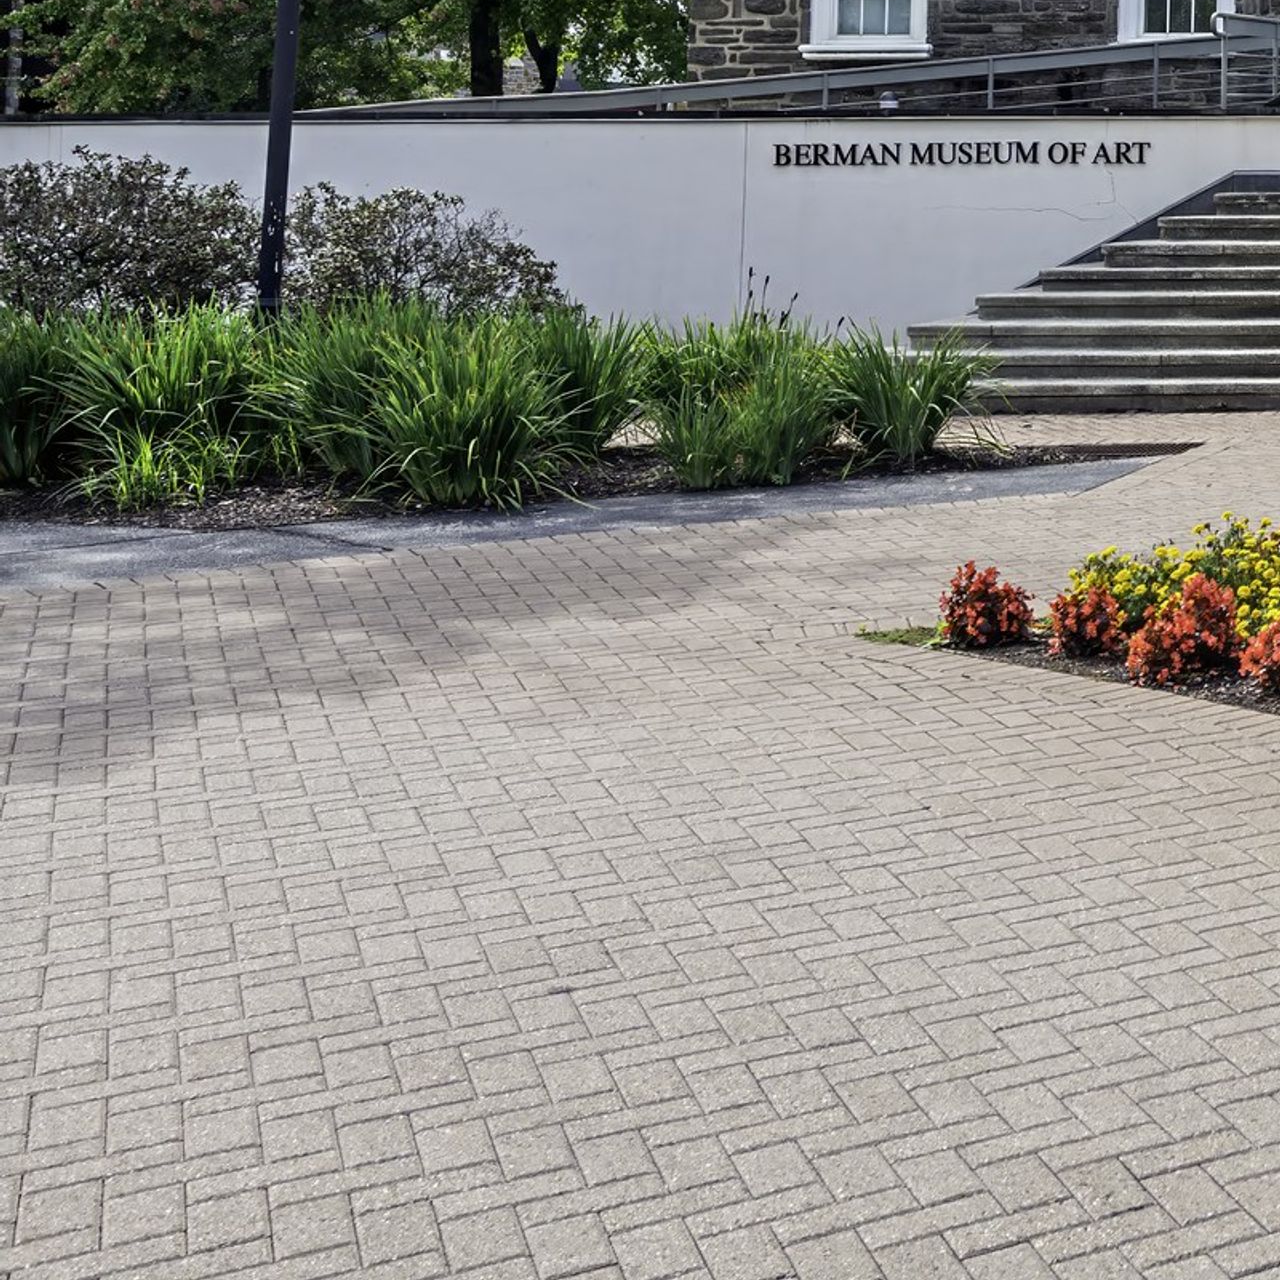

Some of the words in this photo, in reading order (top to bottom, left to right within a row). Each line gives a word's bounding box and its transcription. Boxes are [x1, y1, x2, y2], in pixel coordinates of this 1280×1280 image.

[772, 142, 902, 167] BERMAN
[909, 141, 1039, 166] MUSEUM
[1047, 142, 1086, 164] OF
[1092, 141, 1151, 166] ART
